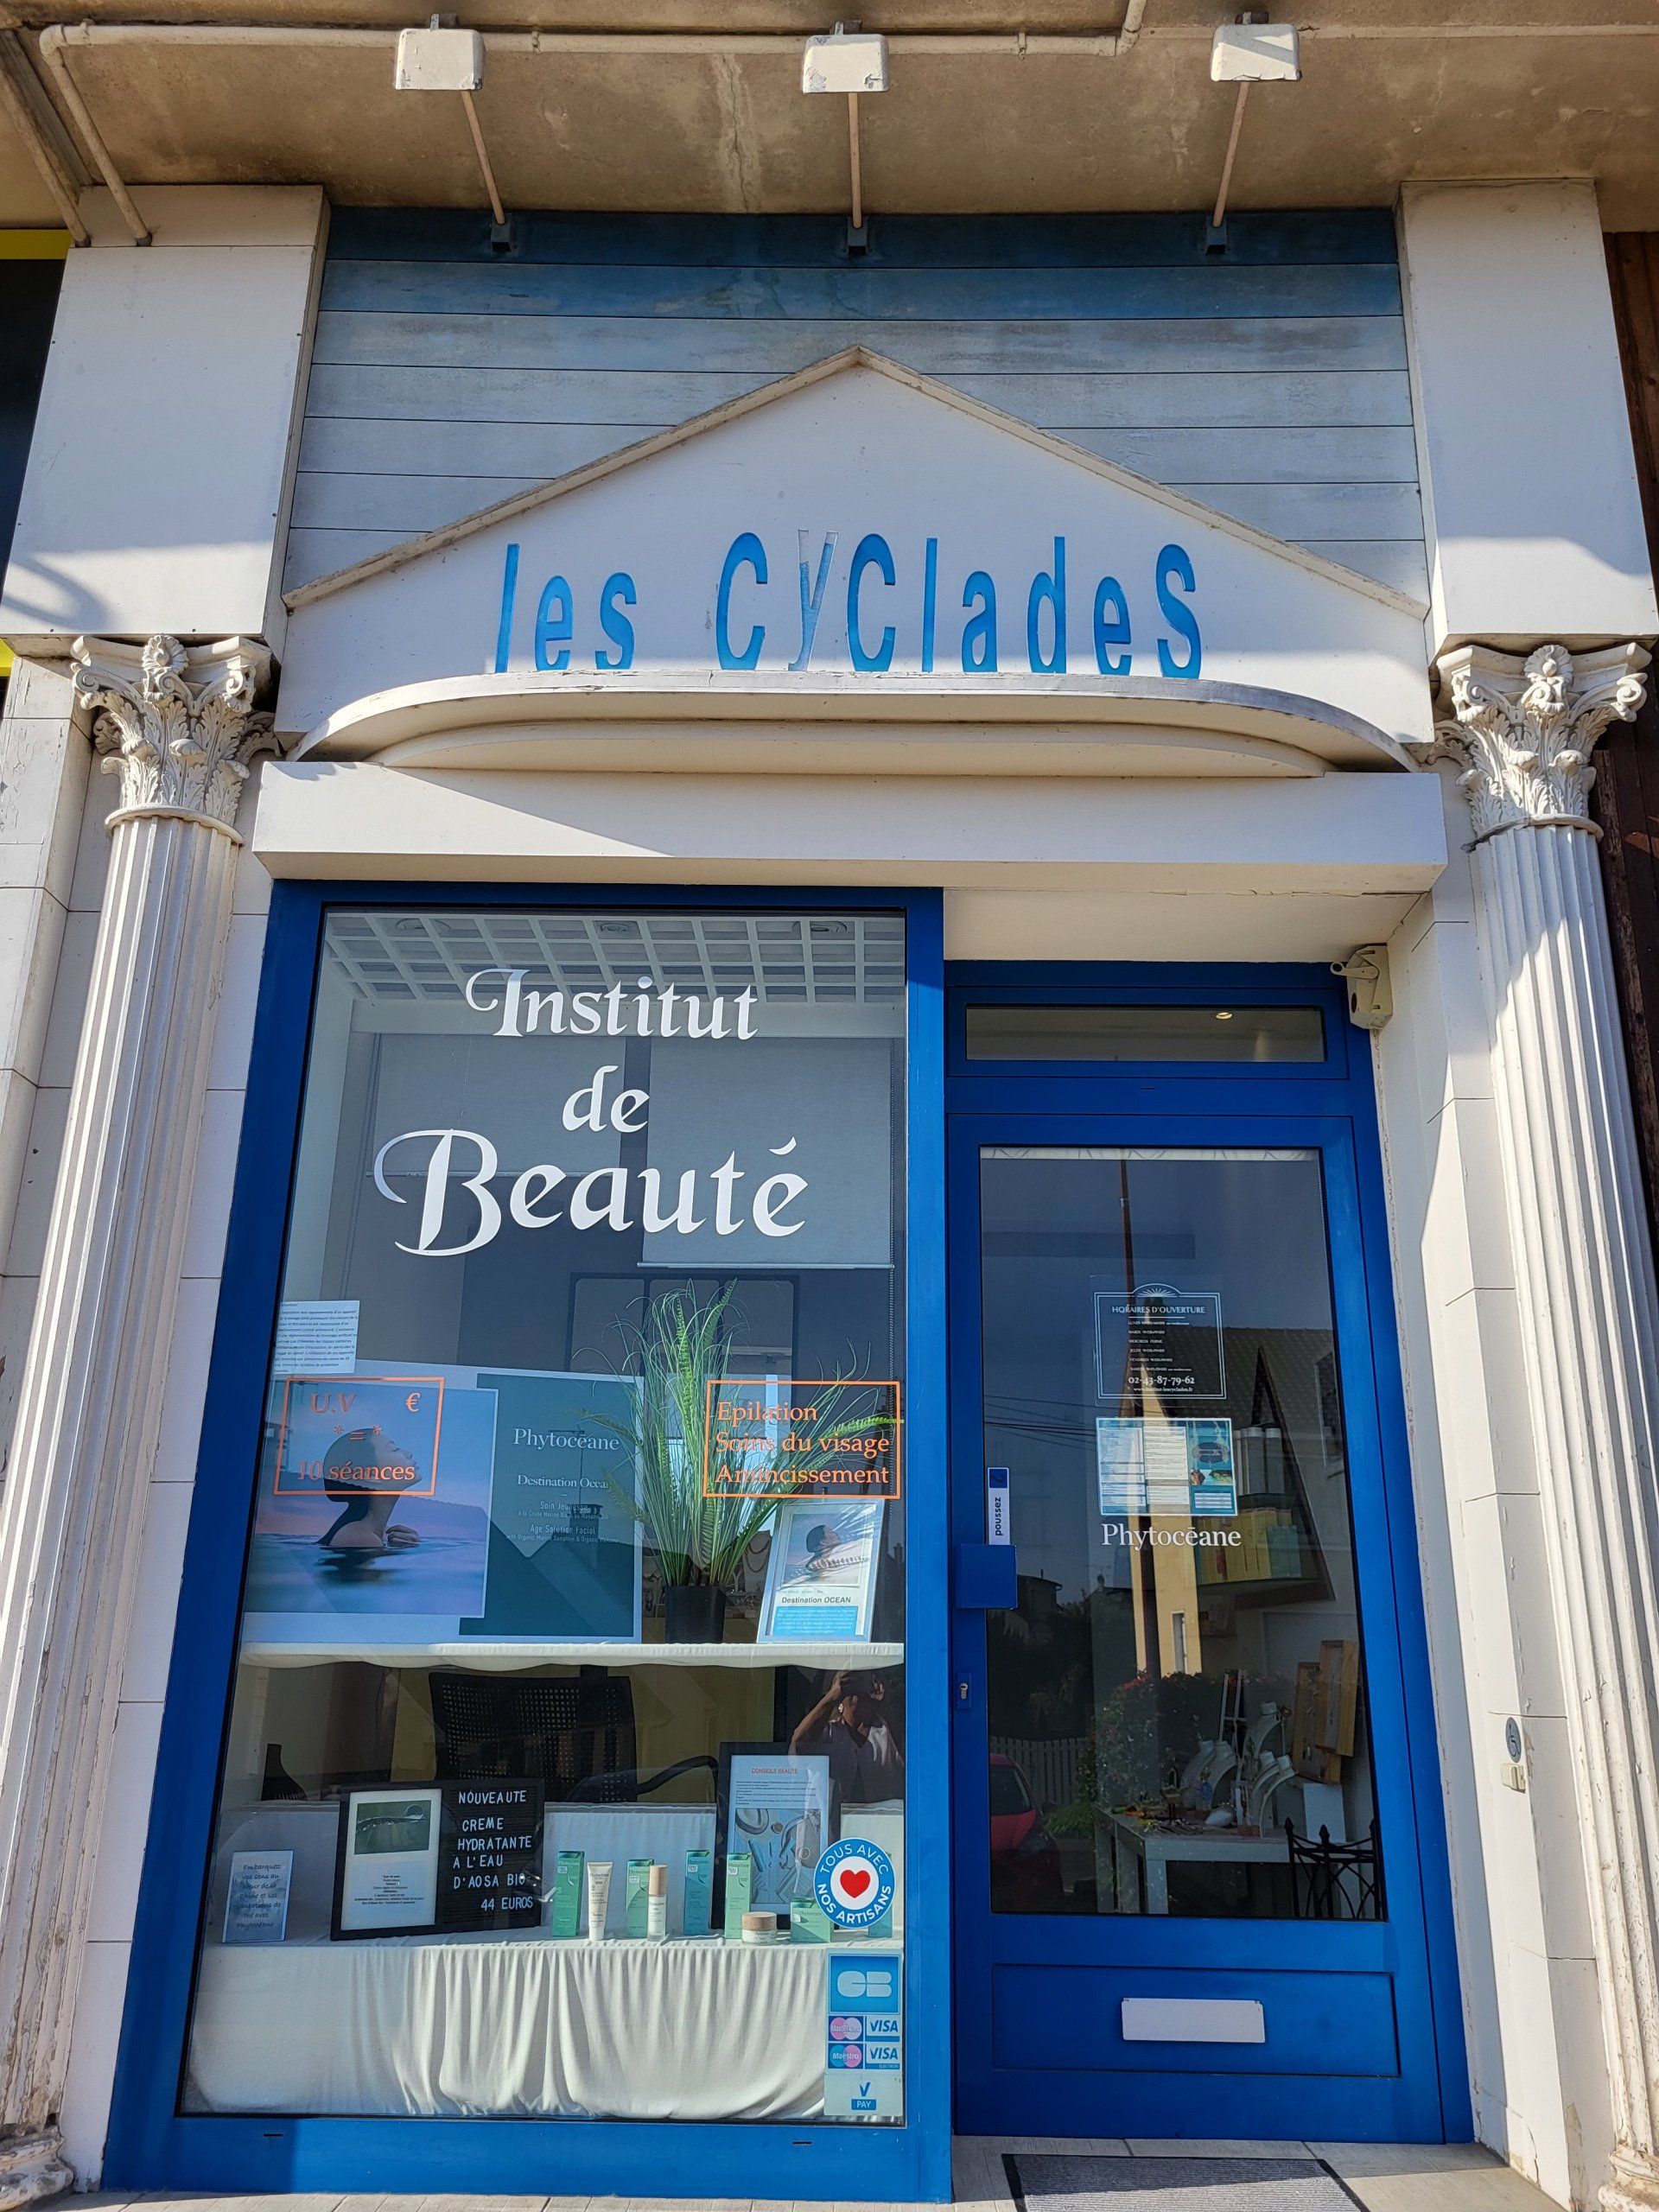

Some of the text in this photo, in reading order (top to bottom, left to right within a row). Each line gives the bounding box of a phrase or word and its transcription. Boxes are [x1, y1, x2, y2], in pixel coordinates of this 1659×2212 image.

[495, 543, 638, 674] les
[465, 968, 758, 1040] Institut
[562, 1065, 650, 1133] de
[374, 1128, 809, 1257] Beauté
[1128, 1376, 1195, 1386] 02-43-87-79-62
[405, 1392, 422, 1413] €
[717, 1401, 818, 1427] Epilation
[715, 1432, 890, 1459] Soins du visage
[297, 1459, 416, 1481] 10 séances
[715, 1464, 890, 1484] Amincissement
[518, 1474, 577, 1488] Destination
[540, 1501, 555, 1510] Soin
[995, 1497, 1003, 1536] poussez
[458, 1789, 527, 1804] NOUVEAUTE
[462, 1817, 505, 1832] CREME
[458, 1835, 532, 1851] HYDRATANTE
[820, 1843, 889, 1875] TOUS AVEC
[506, 1872, 526, 1886] BIO
[480, 1896, 533, 1911] 44 EUROS
[817, 1883, 892, 1924] NOS ARTISANS
[870, 2020, 899, 2032] VISA
[832, 2047, 899, 2061] Maestro VISA
[856, 2100, 872, 2108] PAY
